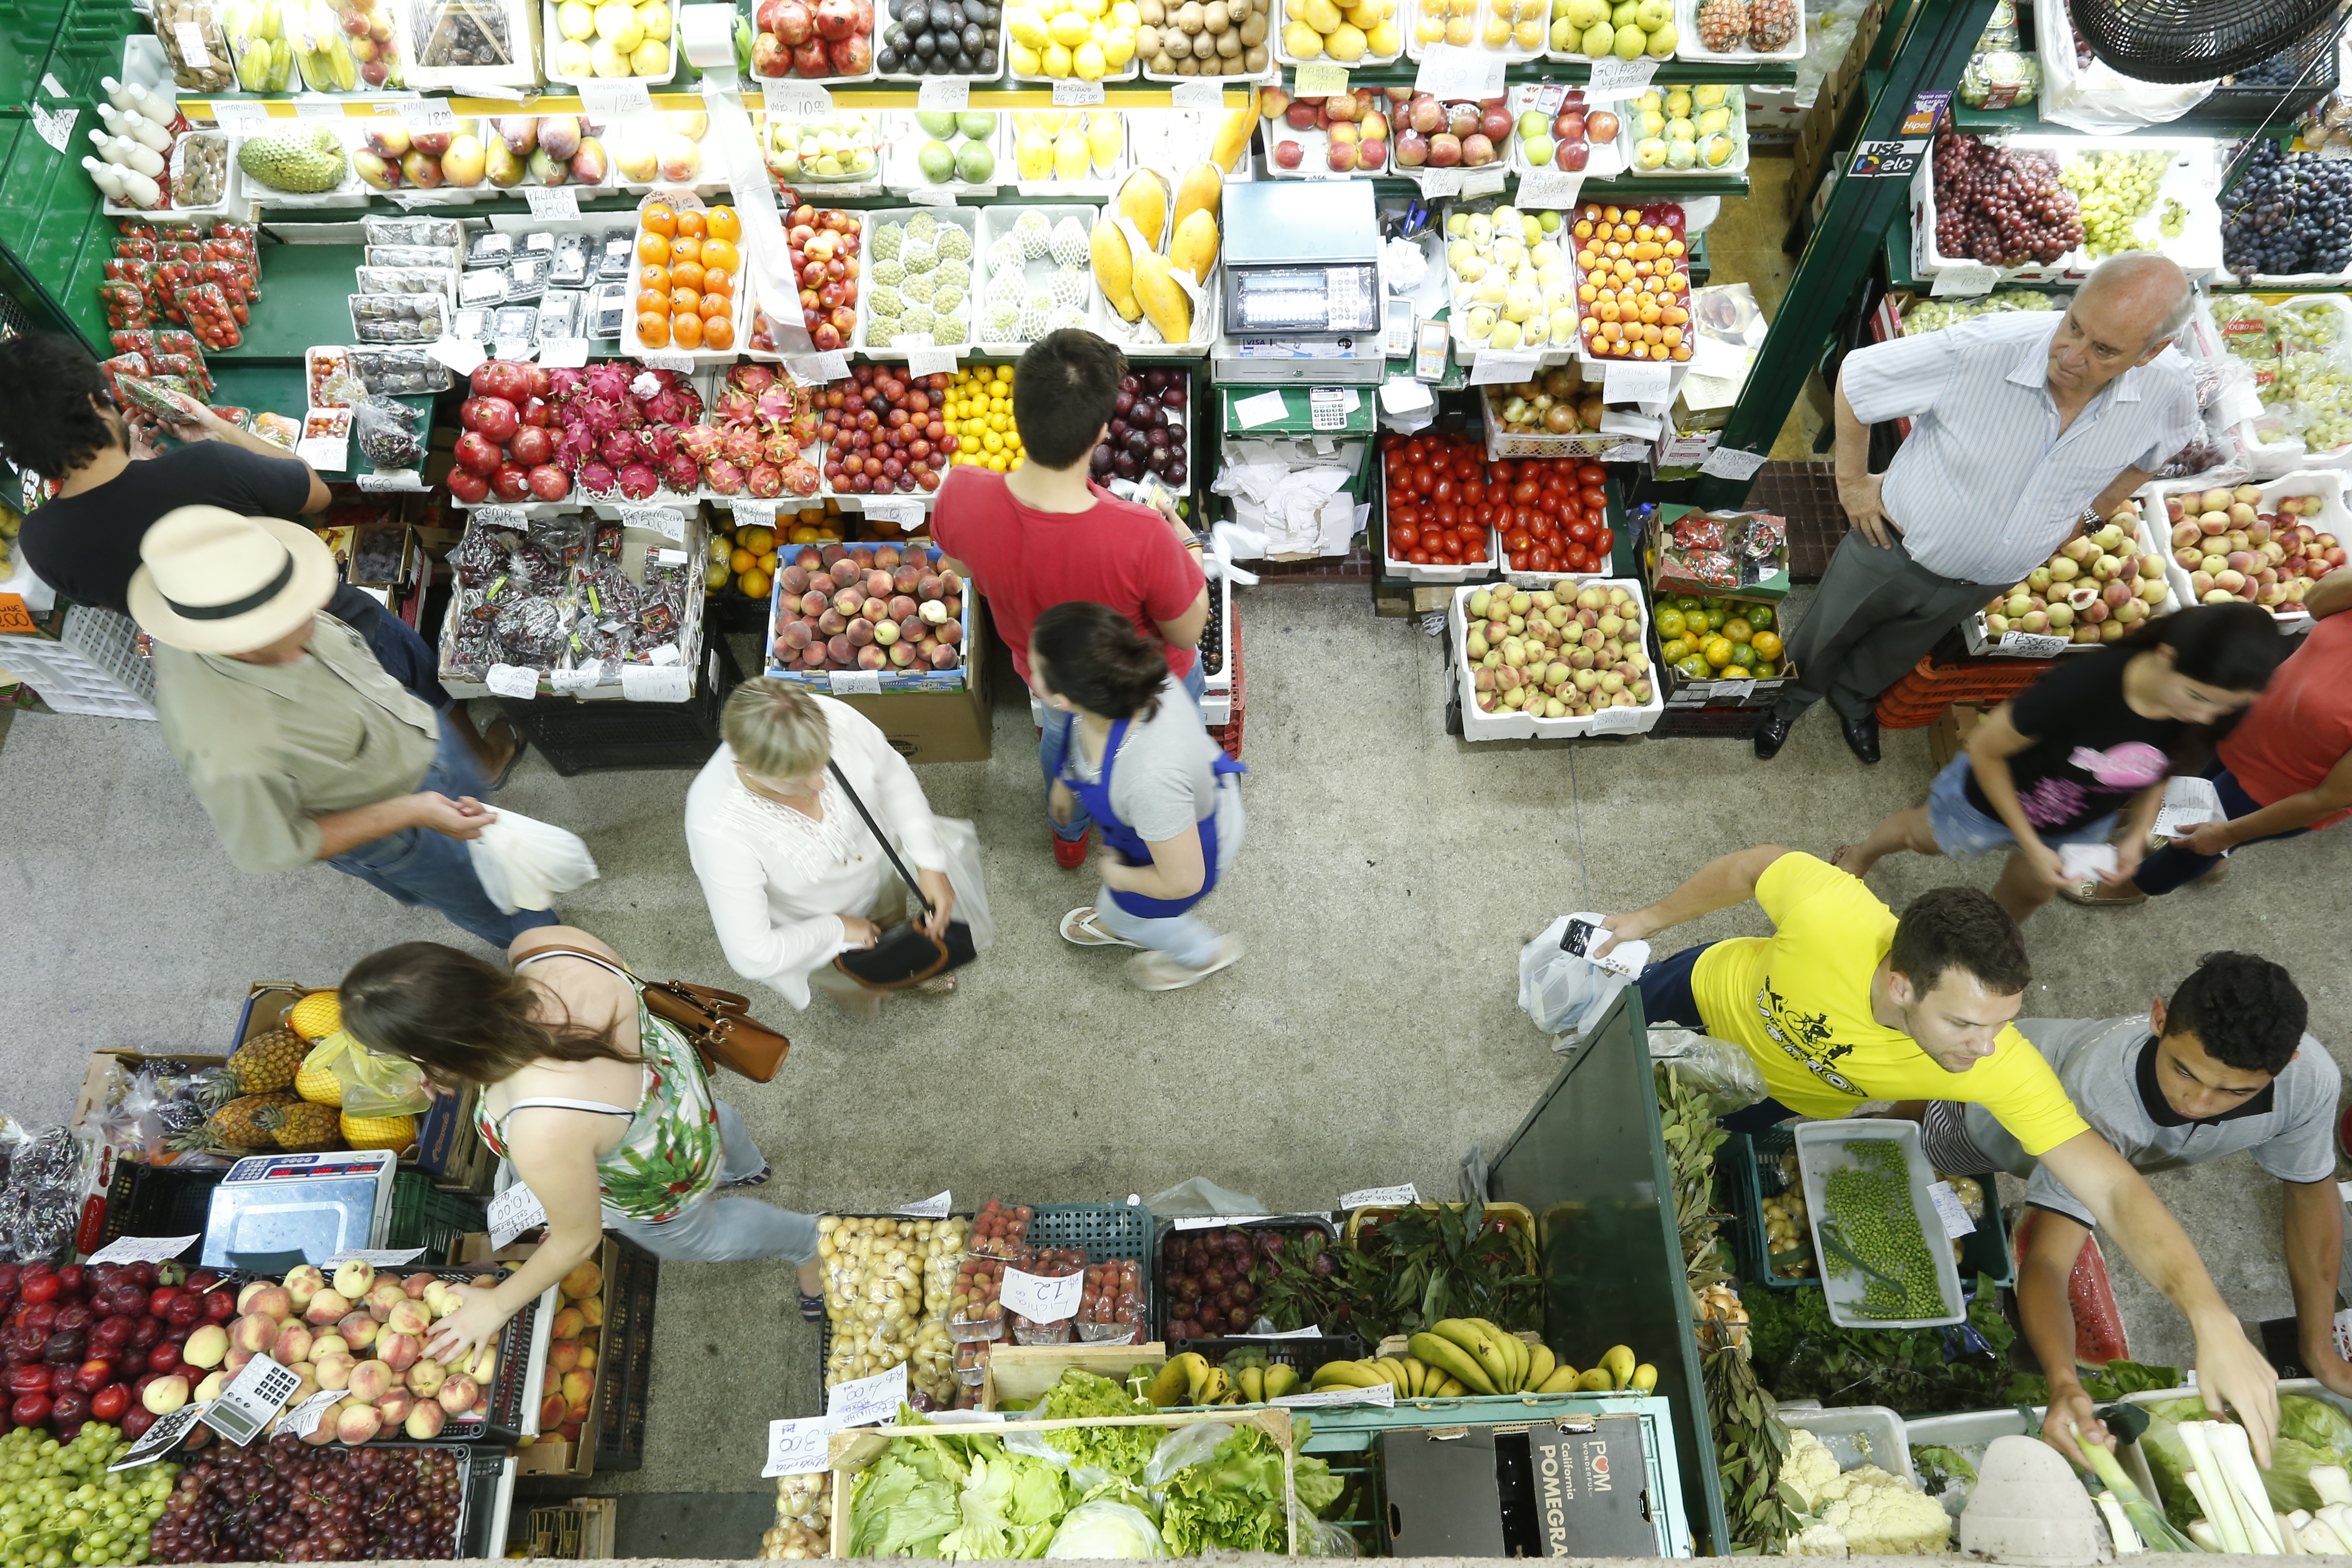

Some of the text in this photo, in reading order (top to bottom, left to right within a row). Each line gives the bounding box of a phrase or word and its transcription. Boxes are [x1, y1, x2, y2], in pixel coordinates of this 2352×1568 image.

[1592, 63, 1646, 78] GOIABA
[403, 102, 425, 112] NONI
[1903, 121, 1931, 130] Hiper
[1881, 157, 1913, 171] elo
[529, 188, 572, 201] PALMER
[1607, 365, 1662, 378] DAMASCO
[361, 477, 392, 489] FIGO
[623, 666, 682, 681] CEREJA
[1018, 1296, 1068, 1318] Lichia
[887, 1368, 903, 1384] R$
[1561, 1442, 1574, 1500] California
[1583, 1442, 1592, 1492] WONDERFUL
[1588, 1441, 1612, 1492] POM
